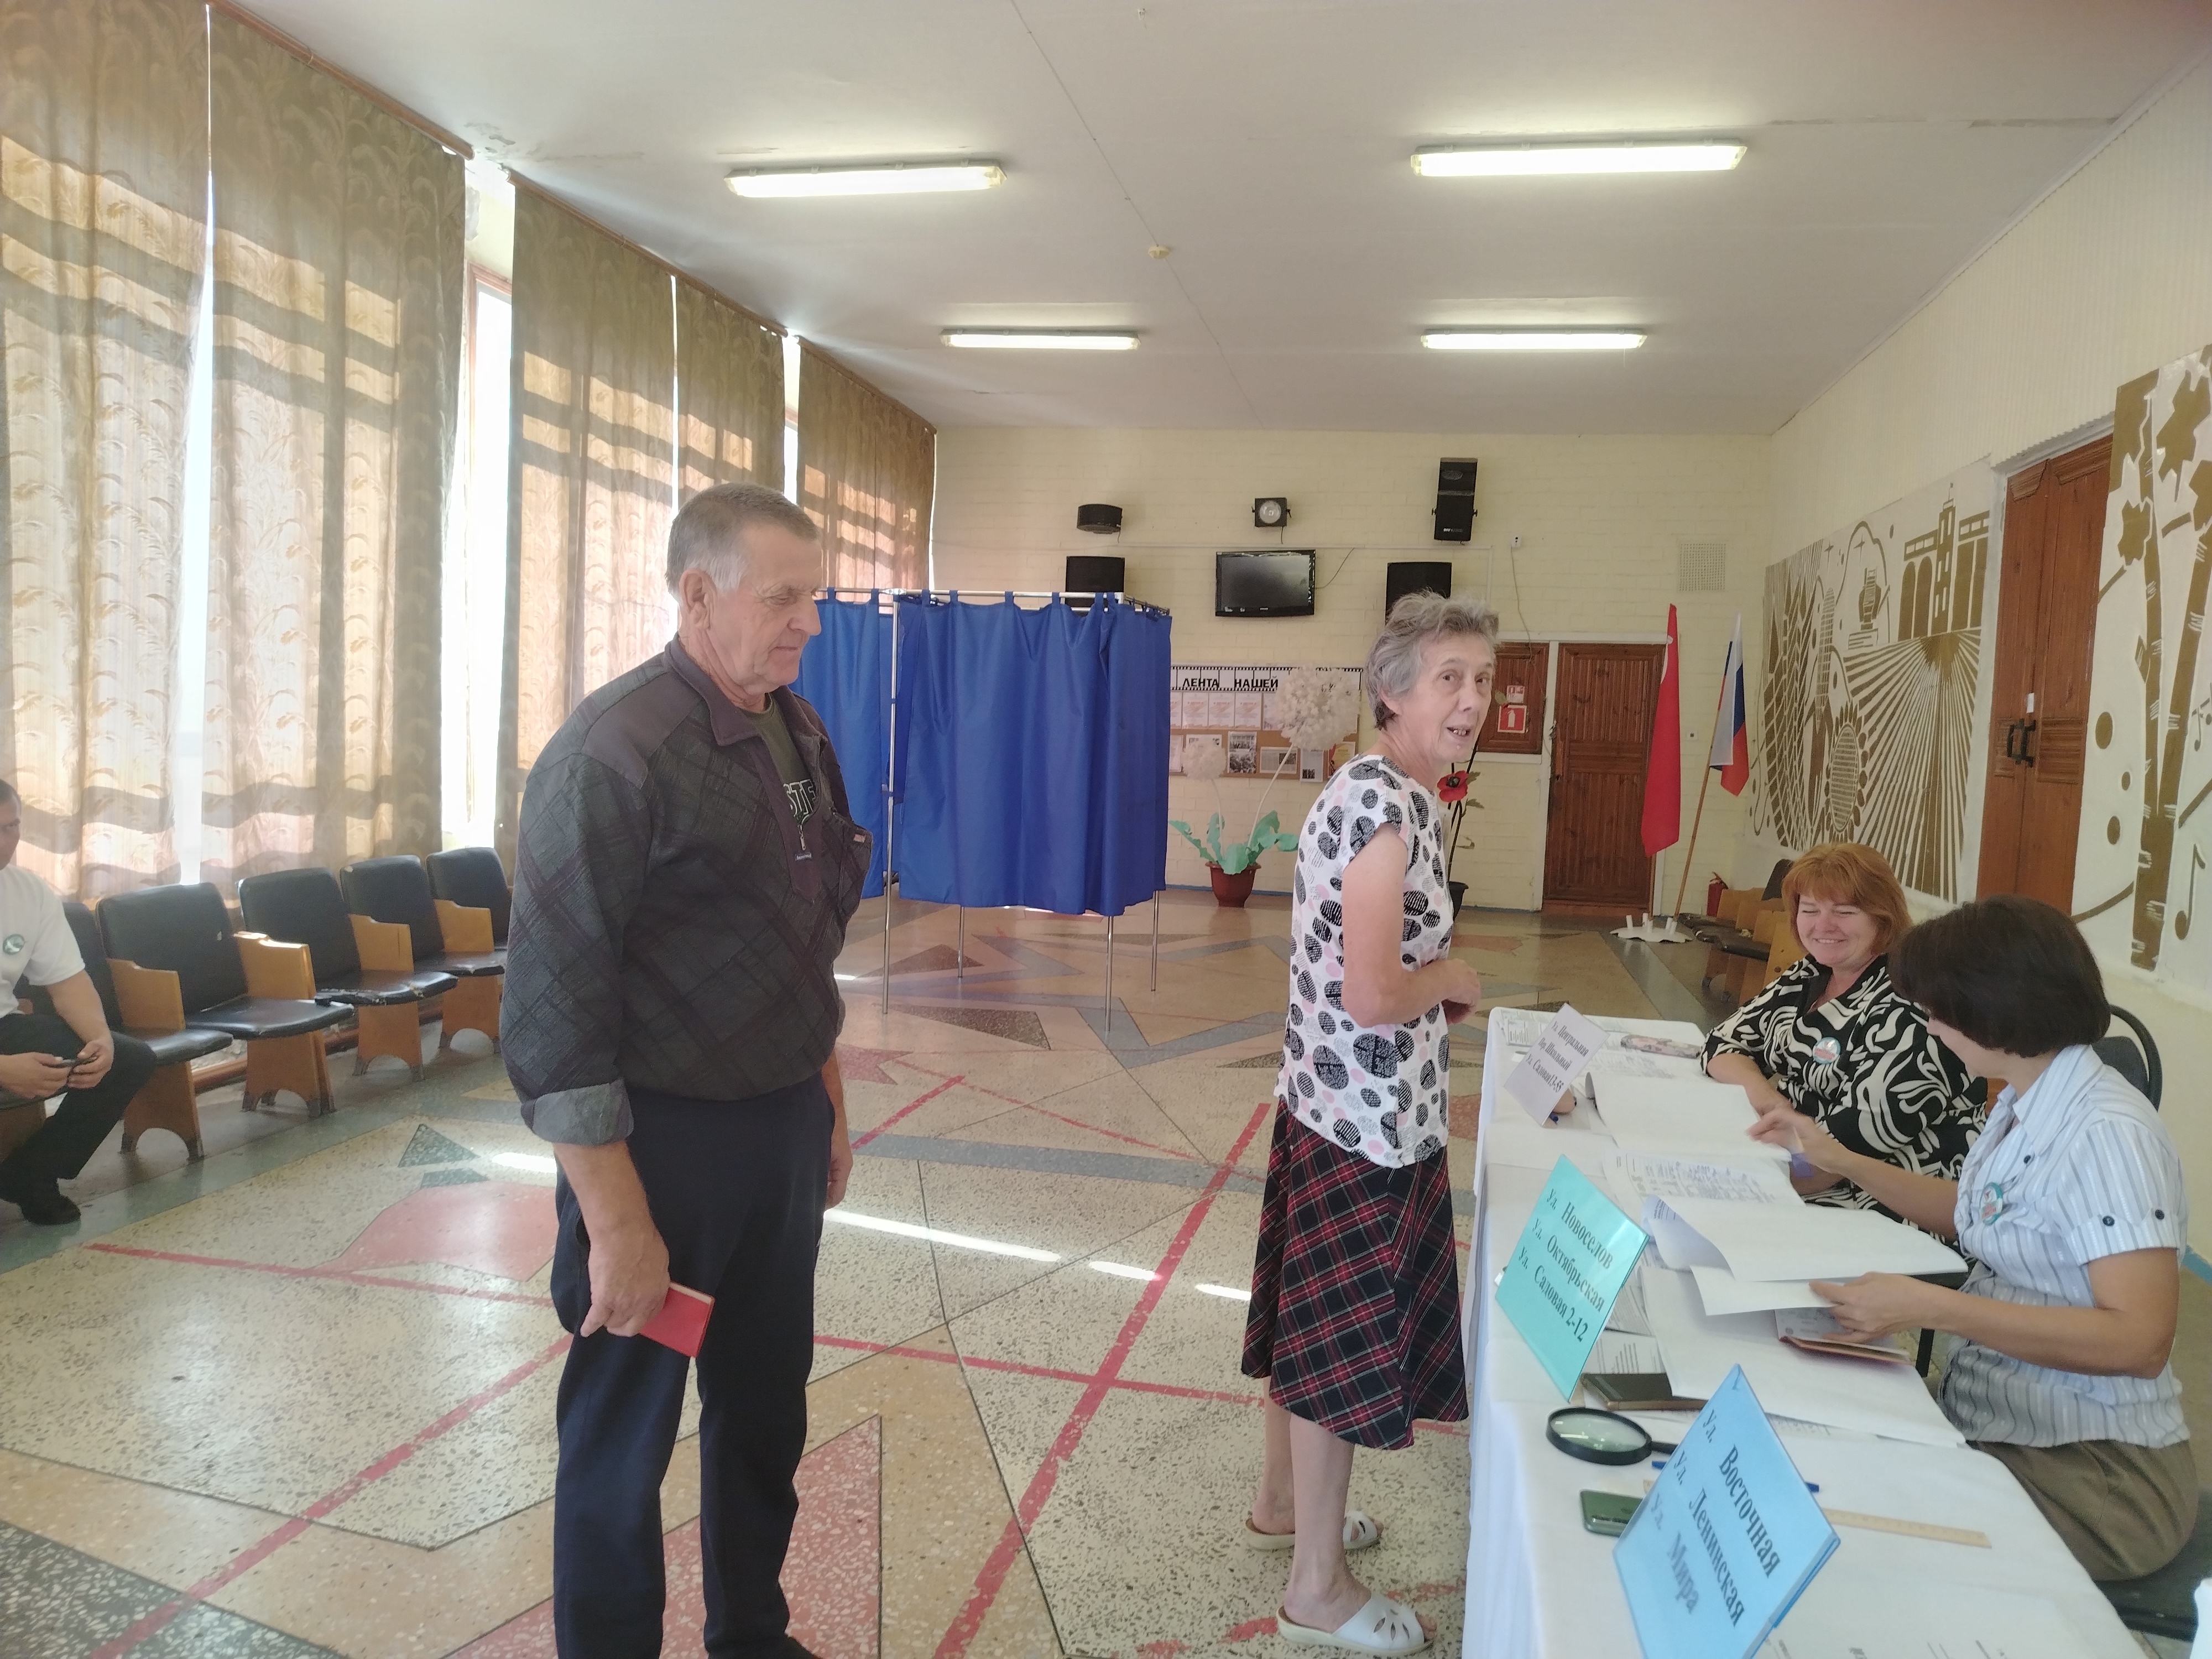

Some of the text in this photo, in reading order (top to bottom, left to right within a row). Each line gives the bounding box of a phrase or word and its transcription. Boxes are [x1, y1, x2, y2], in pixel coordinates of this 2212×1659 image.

[1182, 675, 1279, 688] ЛЕНТА НАШЕЙ
[1545, 1042, 1572, 1071] Школьный
[1557, 1025, 1589, 1057] Центральная
[1532, 1218, 1605, 1313] Ул. Октябрьская
[1546, 1188, 1614, 1270] Ул. Новоселов
[1518, 1246, 1589, 1343] Ул. Садовая 2-12
[1674, 1450, 1746, 1627] Ул. Ленинская
[1703, 1408, 1781, 1579] Ул. Восточная
[1650, 1493, 1699, 1614] Ул. Мира
